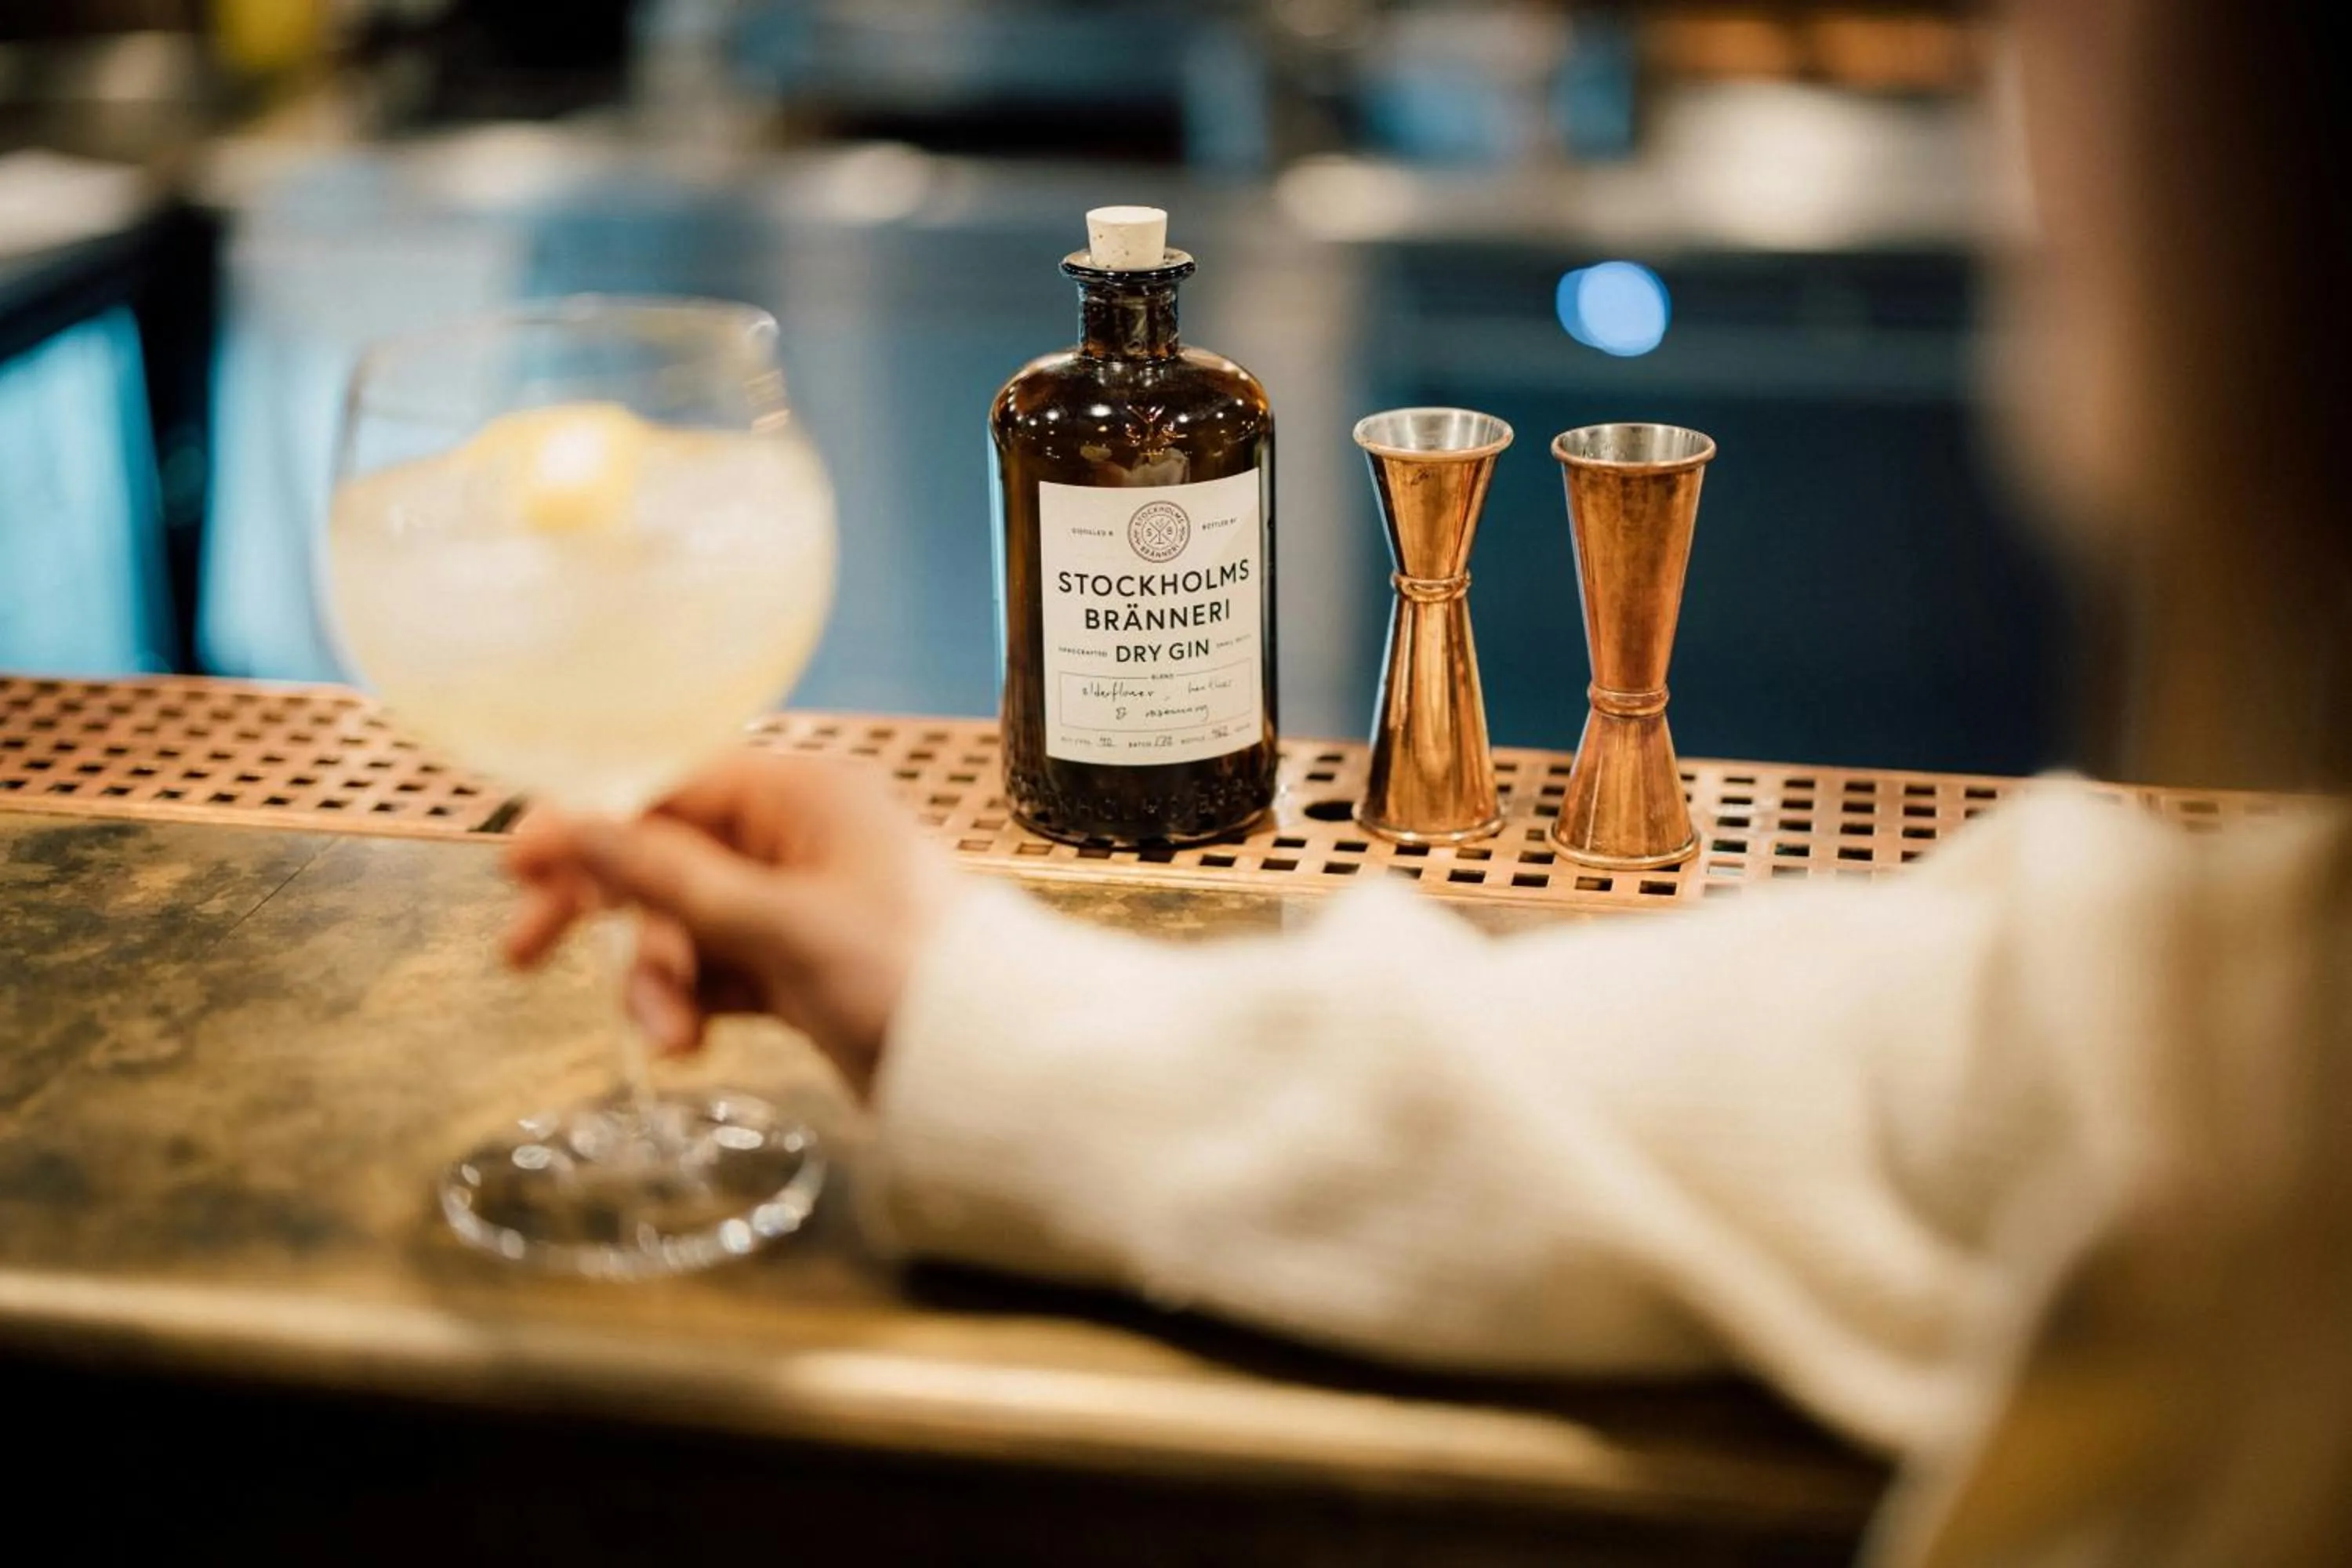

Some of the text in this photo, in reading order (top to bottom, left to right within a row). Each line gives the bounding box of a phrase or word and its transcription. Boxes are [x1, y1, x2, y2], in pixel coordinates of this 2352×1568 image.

[1058, 559, 1250, 597] STOCKHOLMS
[1085, 599, 1230, 631] BRÄNNERI
[1116, 639, 1210, 662] DRY GIN
